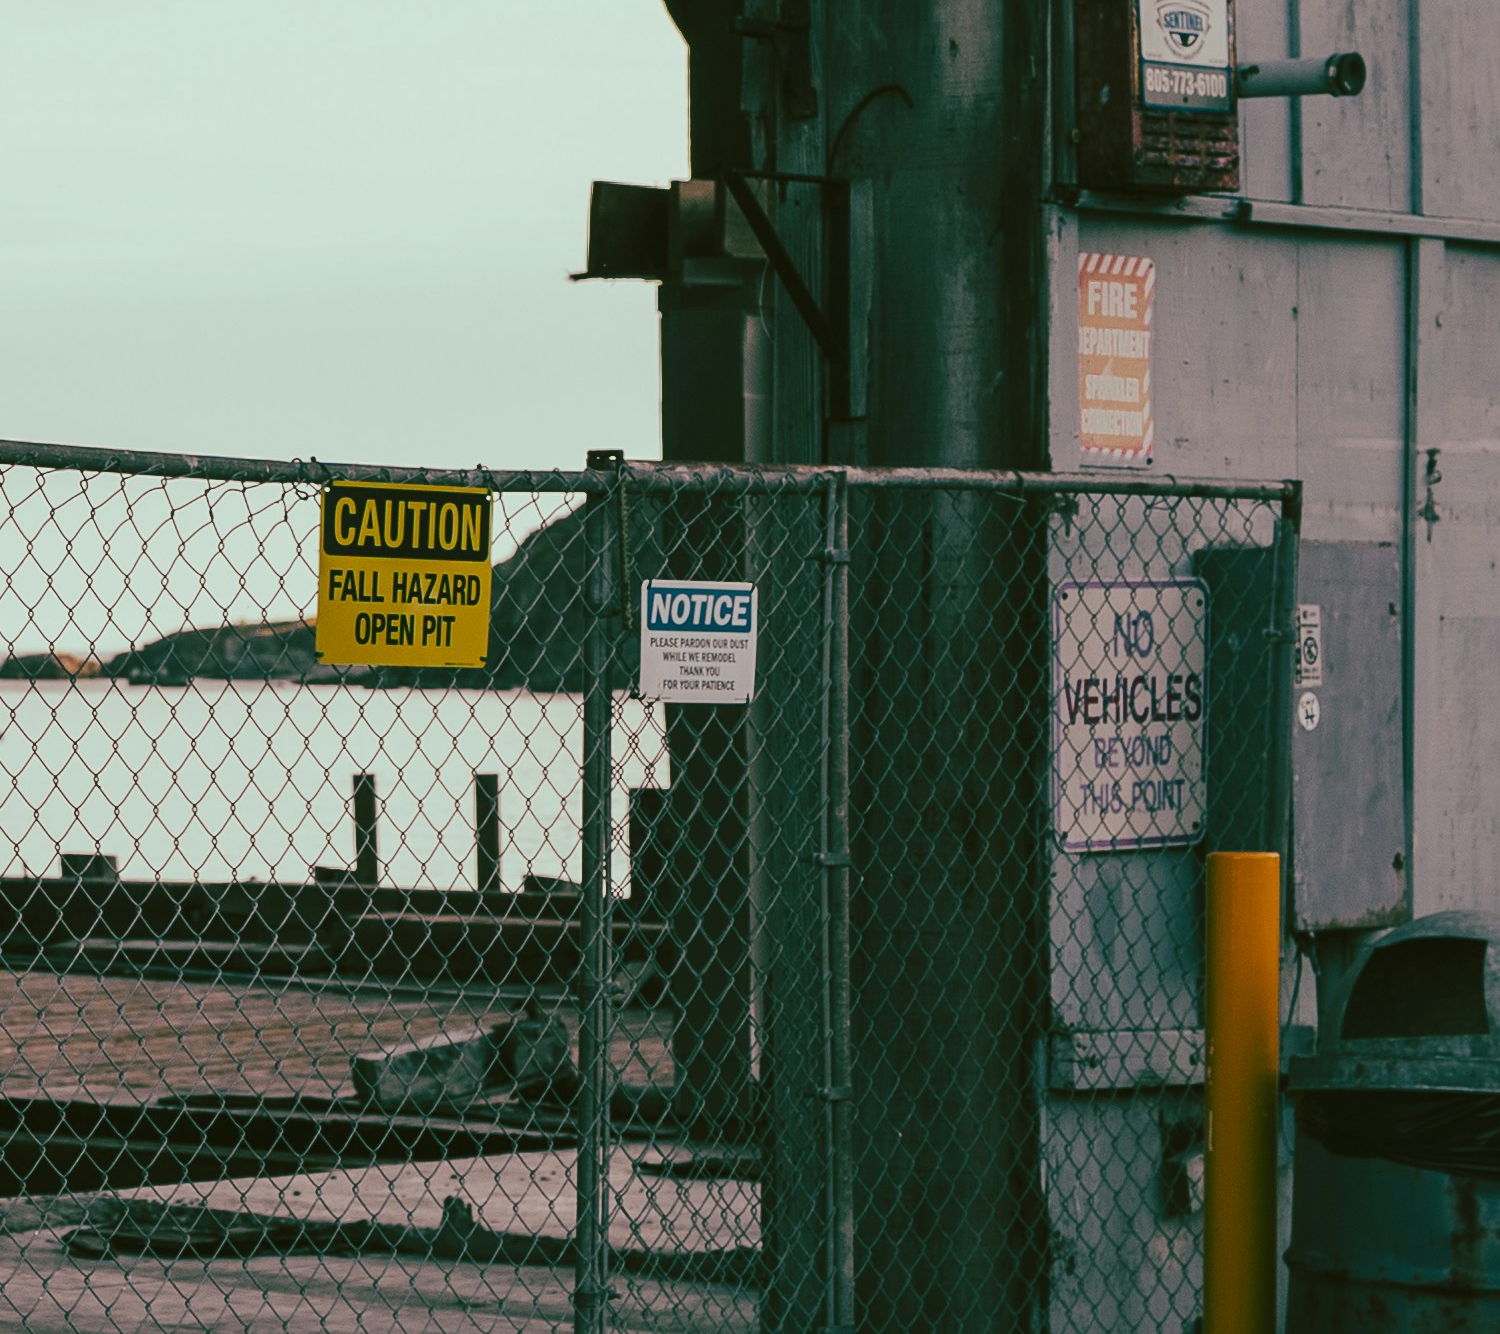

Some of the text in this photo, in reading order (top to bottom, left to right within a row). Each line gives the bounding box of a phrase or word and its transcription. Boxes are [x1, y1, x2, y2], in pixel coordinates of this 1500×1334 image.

[1163, 10, 1204, 32] SENTINEL
[1088, 281, 1138, 319] FIRE
[332, 496, 482, 553] CAUTION
[328, 569, 482, 607] FALL HAZARD
[650, 593, 750, 627] NOTICE
[354, 612, 457, 649] OPEN PIT
[650, 637, 749, 650] PLEASE PARDON OUR DUST
[1113, 610, 1155, 659] NO
[662, 651, 736, 663] WHILE WE REMODEL
[680, 666, 720, 677] THANK YOU
[663, 679, 736, 691] FOR YOUR PATIENCE
[1063, 673, 1202, 726] VEHICLES
[1093, 735, 1172, 768] BEYOND
[1079, 779, 1186, 815] THIS POINT
